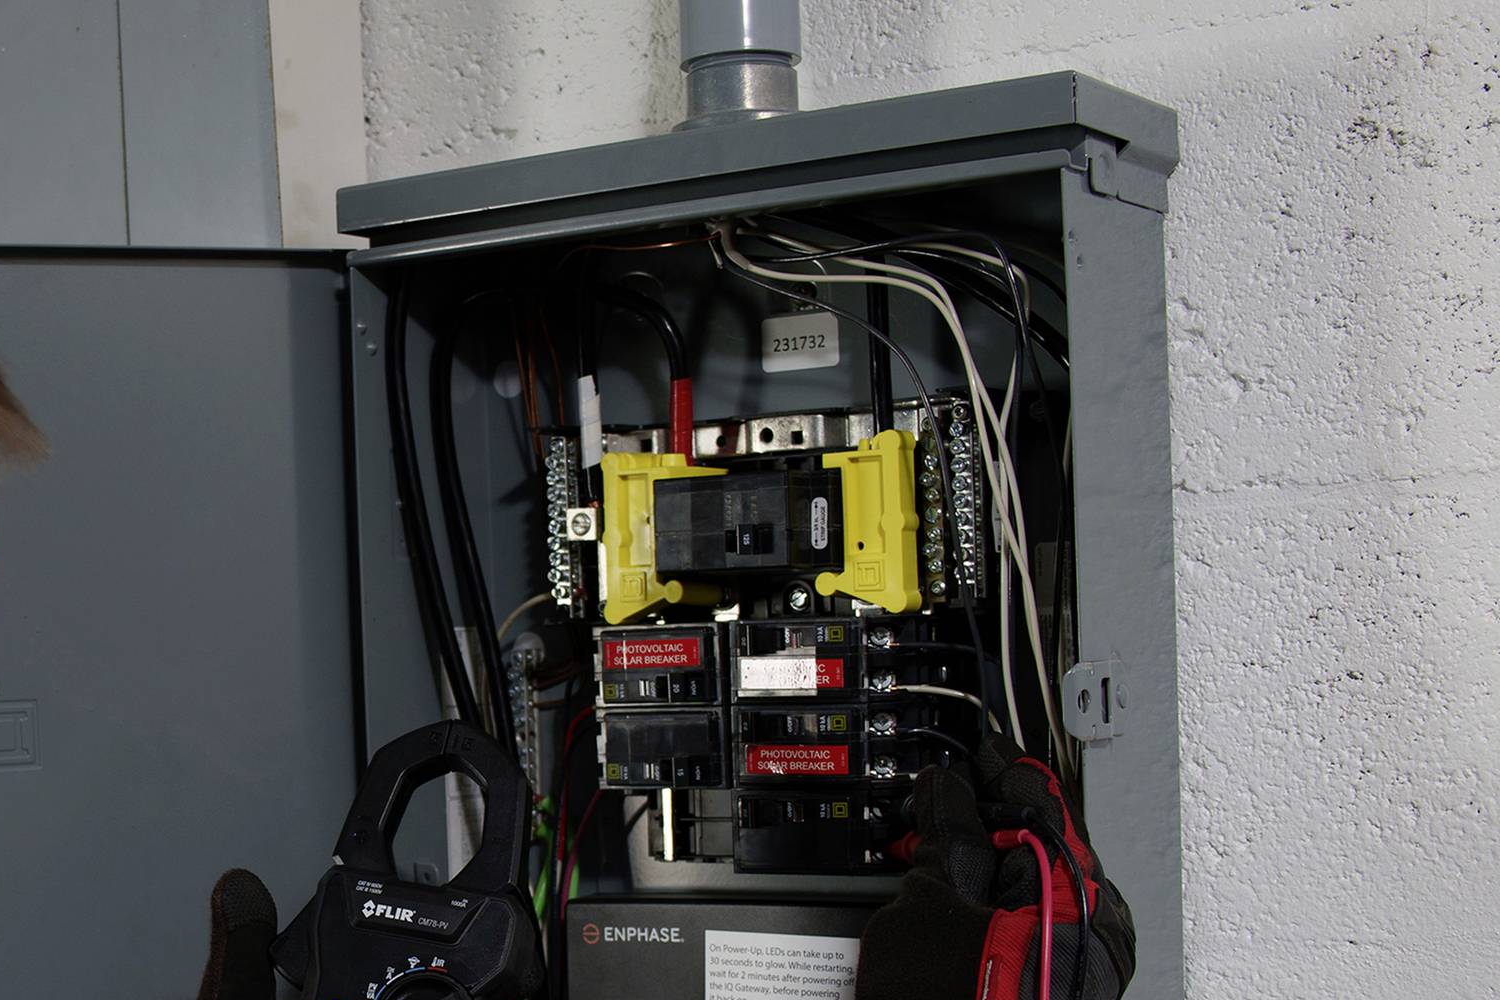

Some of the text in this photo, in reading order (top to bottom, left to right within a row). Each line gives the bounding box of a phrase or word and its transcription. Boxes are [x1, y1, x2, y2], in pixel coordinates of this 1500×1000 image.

[773, 335, 826, 352] 231732
[614, 654, 688, 665] SOLAR BREAKER
[760, 750, 831, 759] PHOTOVOLTAIC
[789, 761, 835, 771] BREAKER
[375, 904, 414, 923] FLIR
[604, 927, 681, 943] ENPHASE
[709, 943, 722, 952] On
[765, 947, 785, 956] LEDs
[803, 950, 820, 958] take
[822, 952, 834, 961] up
[835, 951, 844, 960] to
[709, 956, 719, 965] 30
[721, 957, 753, 967] seconds
[755, 959, 763, 968] to
[788, 961, 811, 971] While
[709, 969, 726, 978] wait
[728, 970, 739, 979] for
[747, 972, 780, 982] minutes
[781, 974, 801, 983] after
[802, 976, 842, 988] powering
[709, 981, 723, 990] the
[772, 986, 800, 995] before
[801, 989, 840, 1000] powering
